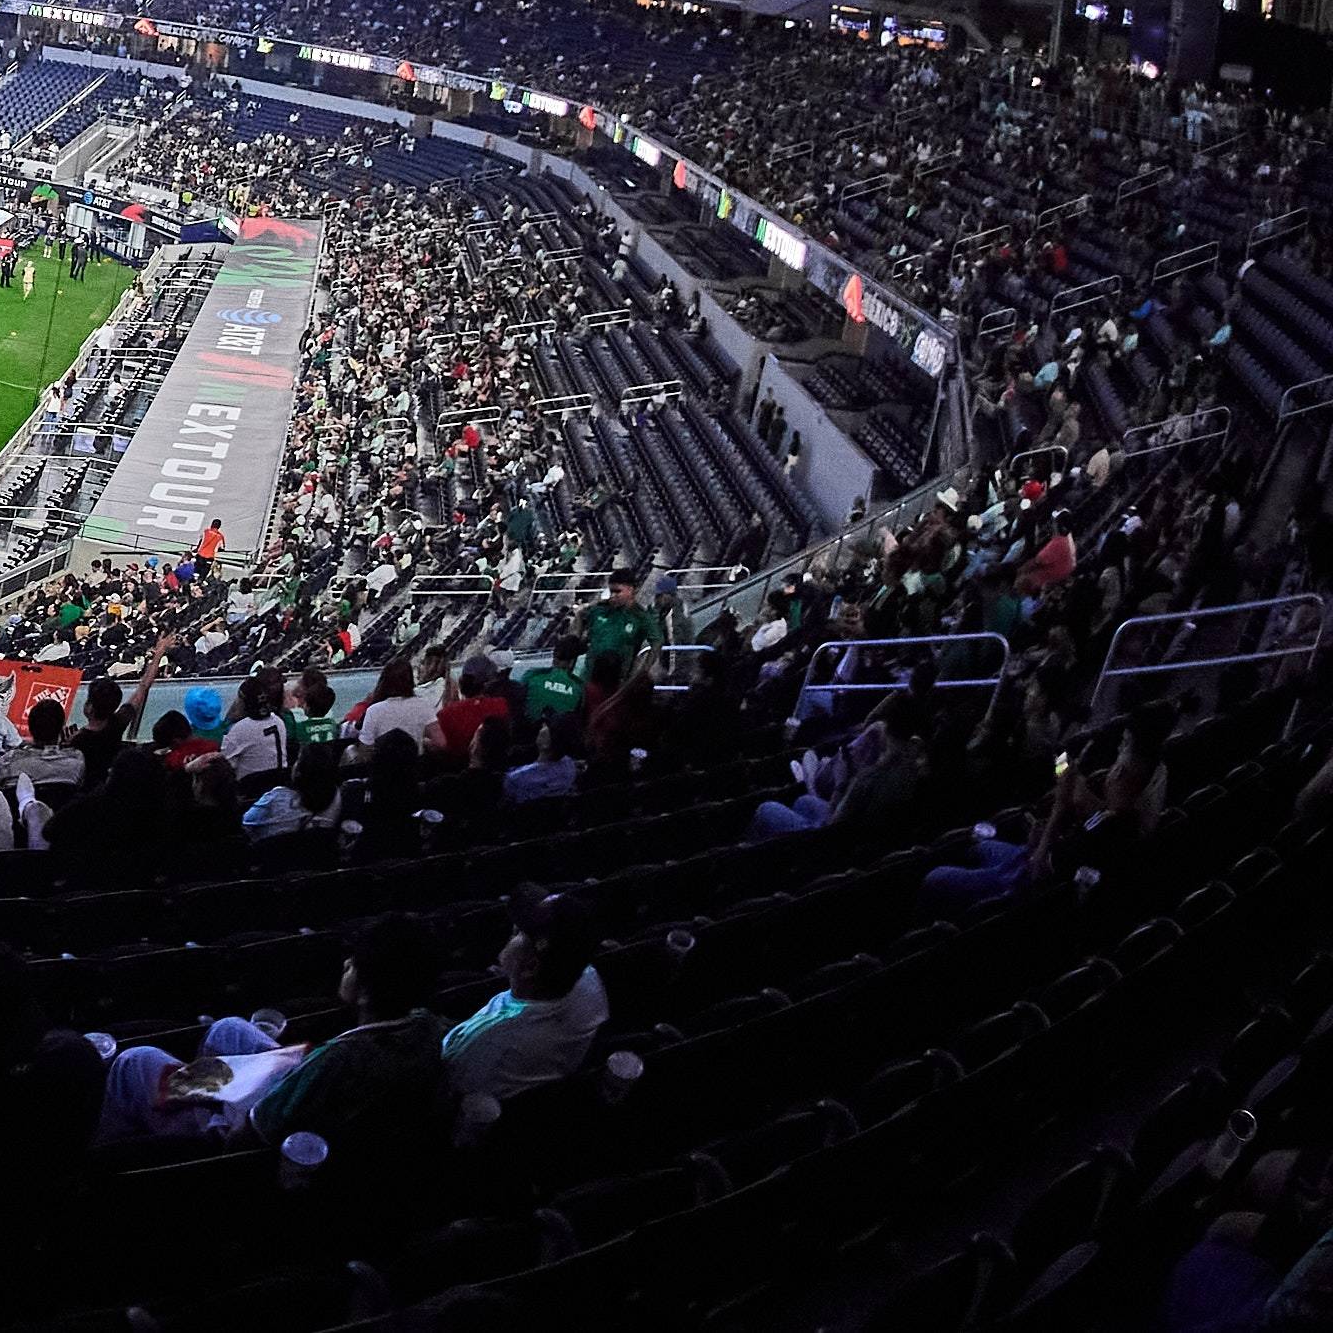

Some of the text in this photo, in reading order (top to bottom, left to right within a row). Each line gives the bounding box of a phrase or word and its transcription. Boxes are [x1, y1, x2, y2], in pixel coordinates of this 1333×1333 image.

[93, 197, 112, 208] AT&T
[217, 323, 270, 355] AT&T
[544, 680, 573, 695] PUEBLA
